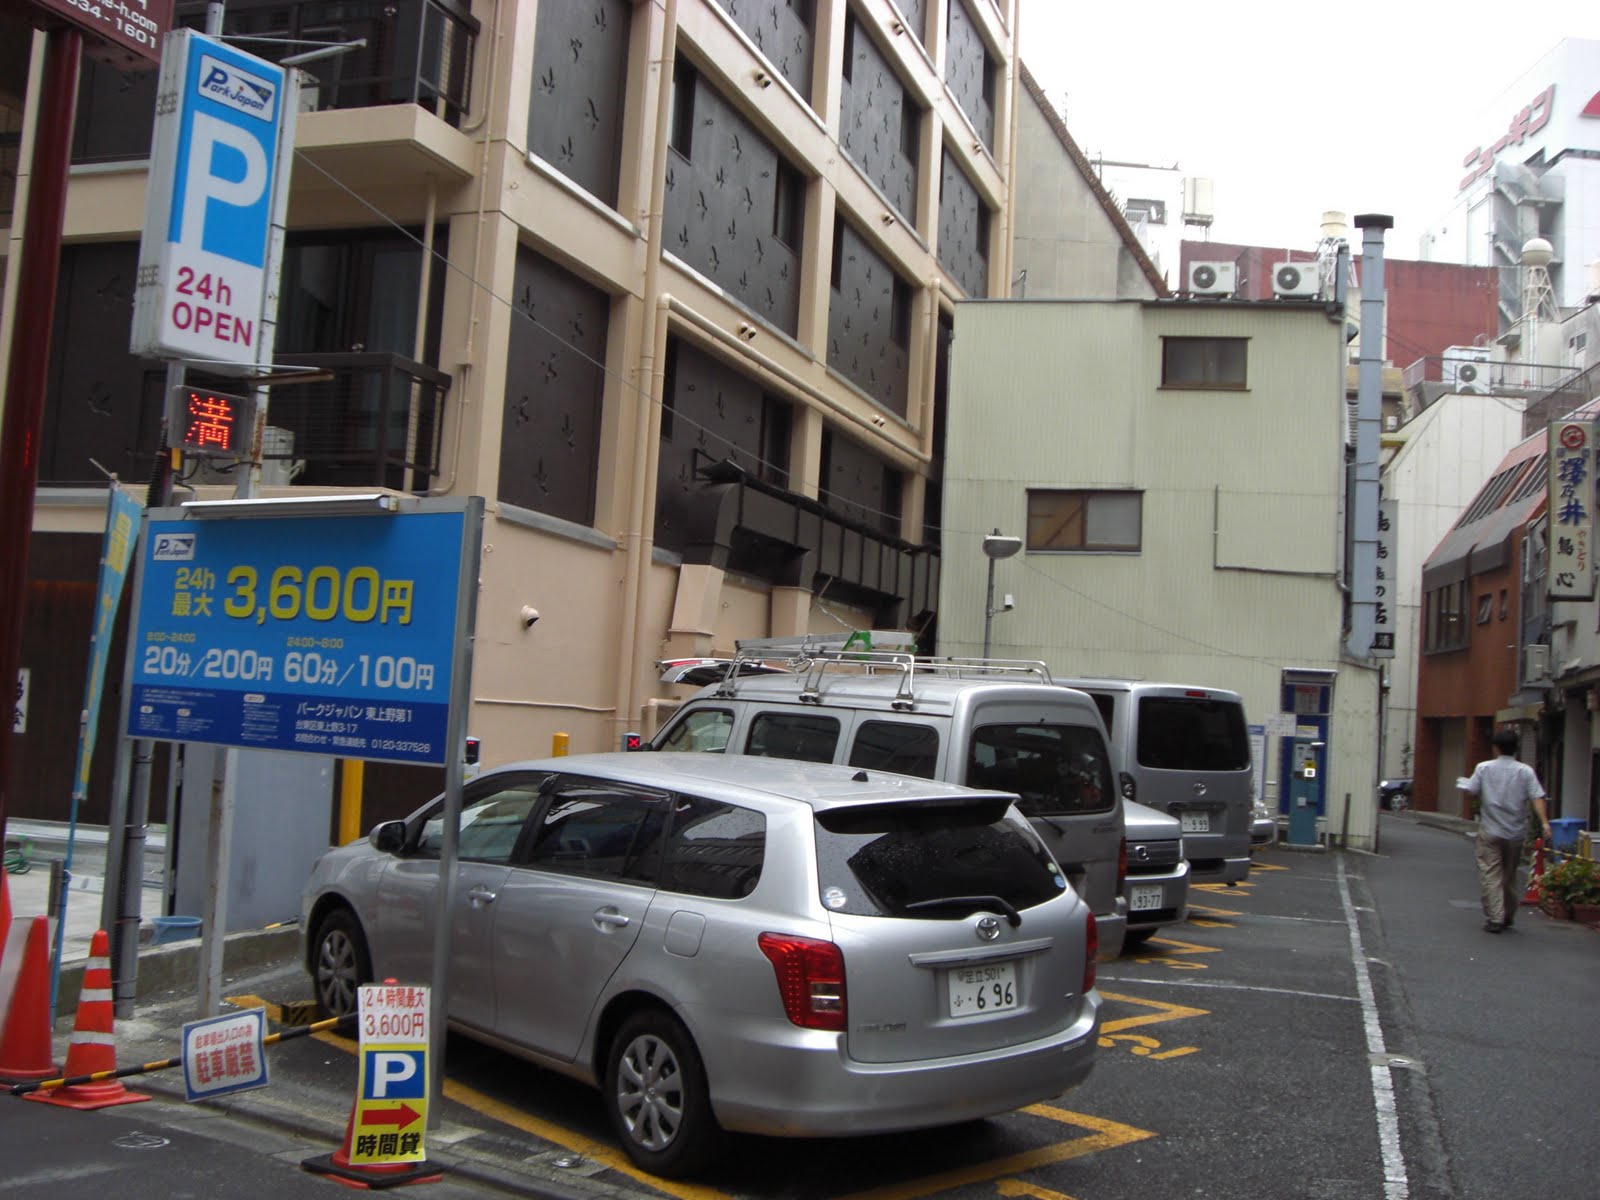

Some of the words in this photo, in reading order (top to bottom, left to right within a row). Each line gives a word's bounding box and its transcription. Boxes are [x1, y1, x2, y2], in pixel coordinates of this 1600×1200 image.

[201, 66, 231, 97] Park
[230, 88, 265, 110] Japan
[180, 111, 268, 250] P
[176, 266, 233, 306] 24h
[172, 300, 253, 347] OPEN
[185, 393, 233, 450] 満
[175, 567, 215, 590] 24h
[223, 565, 414, 625] 3,600円
[171, 592, 214, 616] 最大
[296, 702, 363, 719] パークジャパン
[365, 1012, 425, 1038] 3,600円
[195, 1041, 256, 1085] 駐車厳禁
[372, 1053, 417, 1098] P
[356, 1132, 421, 1157] 時間貸
